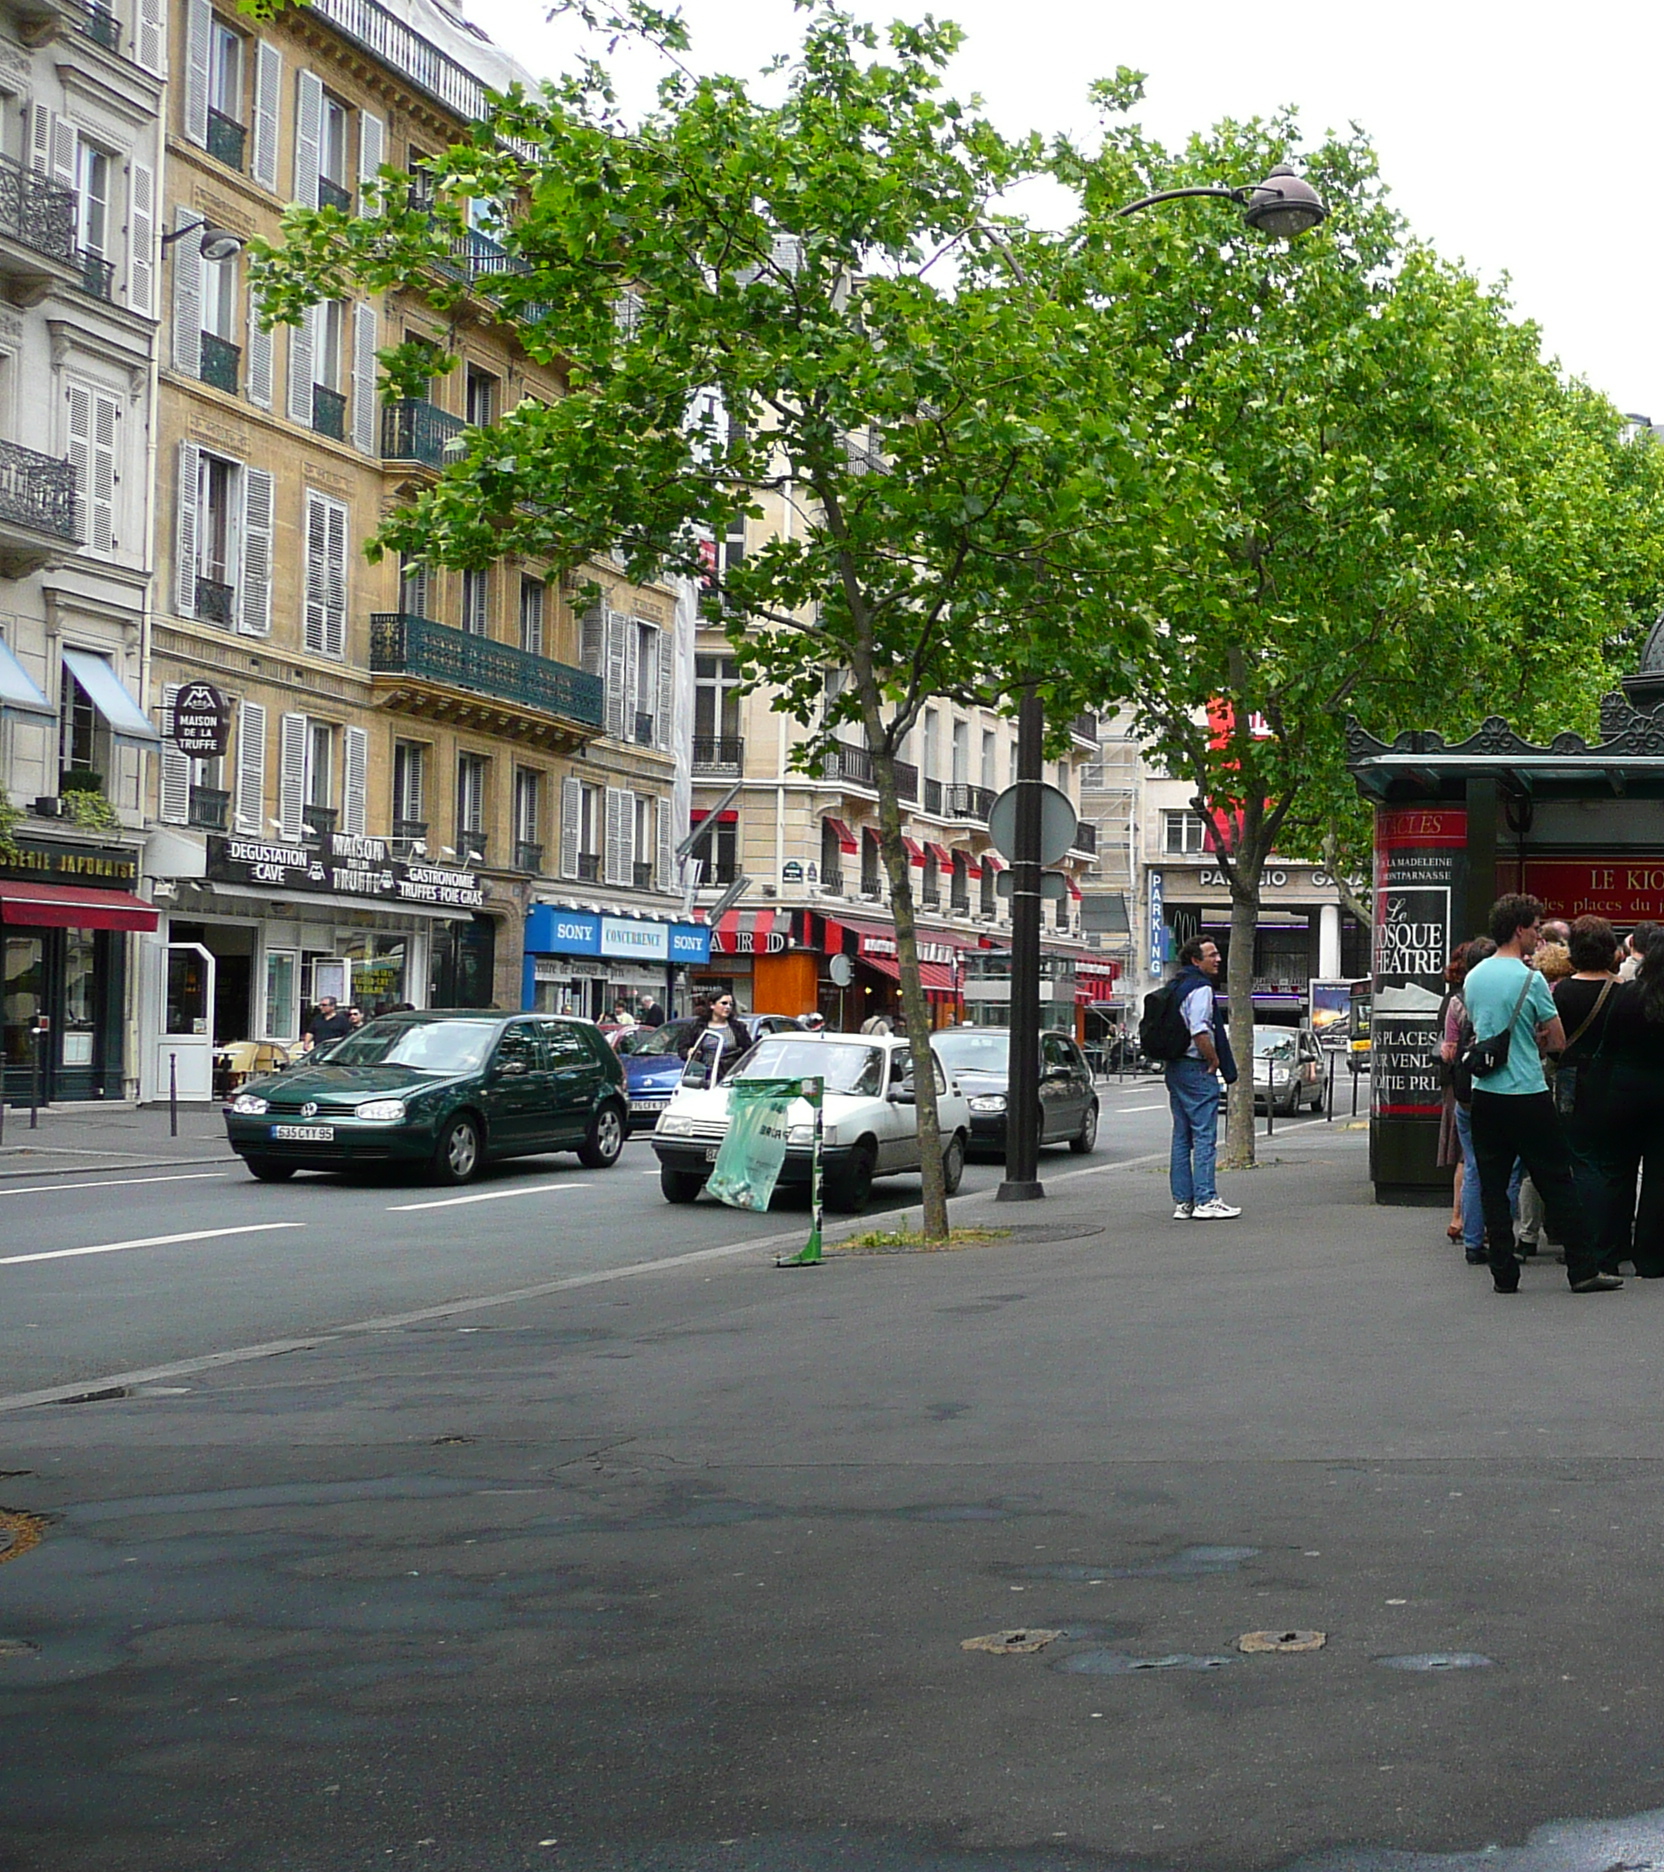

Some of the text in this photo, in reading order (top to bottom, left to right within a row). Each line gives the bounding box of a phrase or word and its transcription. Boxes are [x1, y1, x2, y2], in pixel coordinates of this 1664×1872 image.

[180, 715, 217, 726] MAISON
[184, 728, 212, 737] DE LA
[179, 739, 218, 750] TRUFFE
[231, 842, 307, 867] DEGUSTATION
[332, 834, 385, 861] MAISON
[60, 854, 136, 878] JAPONAISE
[1397, 857, 1453, 867] MADELEINE
[256, 864, 285, 881] CAVE
[409, 867, 475, 889] GASTRONOMIE
[1590, 869, 1615, 890] LE
[400, 882, 437, 900] TRUFFES
[460, 889, 483, 906] GRAS
[1385, 898, 1407, 922] Le
[1573, 897, 1622, 915] places
[1630, 898, 1650, 911] du
[557, 923, 593, 941] SONY
[1151, 875, 1161, 973] PARKING
[606, 928, 661, 947] CONCURRENCE
[674, 935, 703, 951] SONY
[1383, 1031, 1438, 1046] PLACES
[299, 1127, 317, 1139] CYY
[319, 1128, 332, 1139] 95
